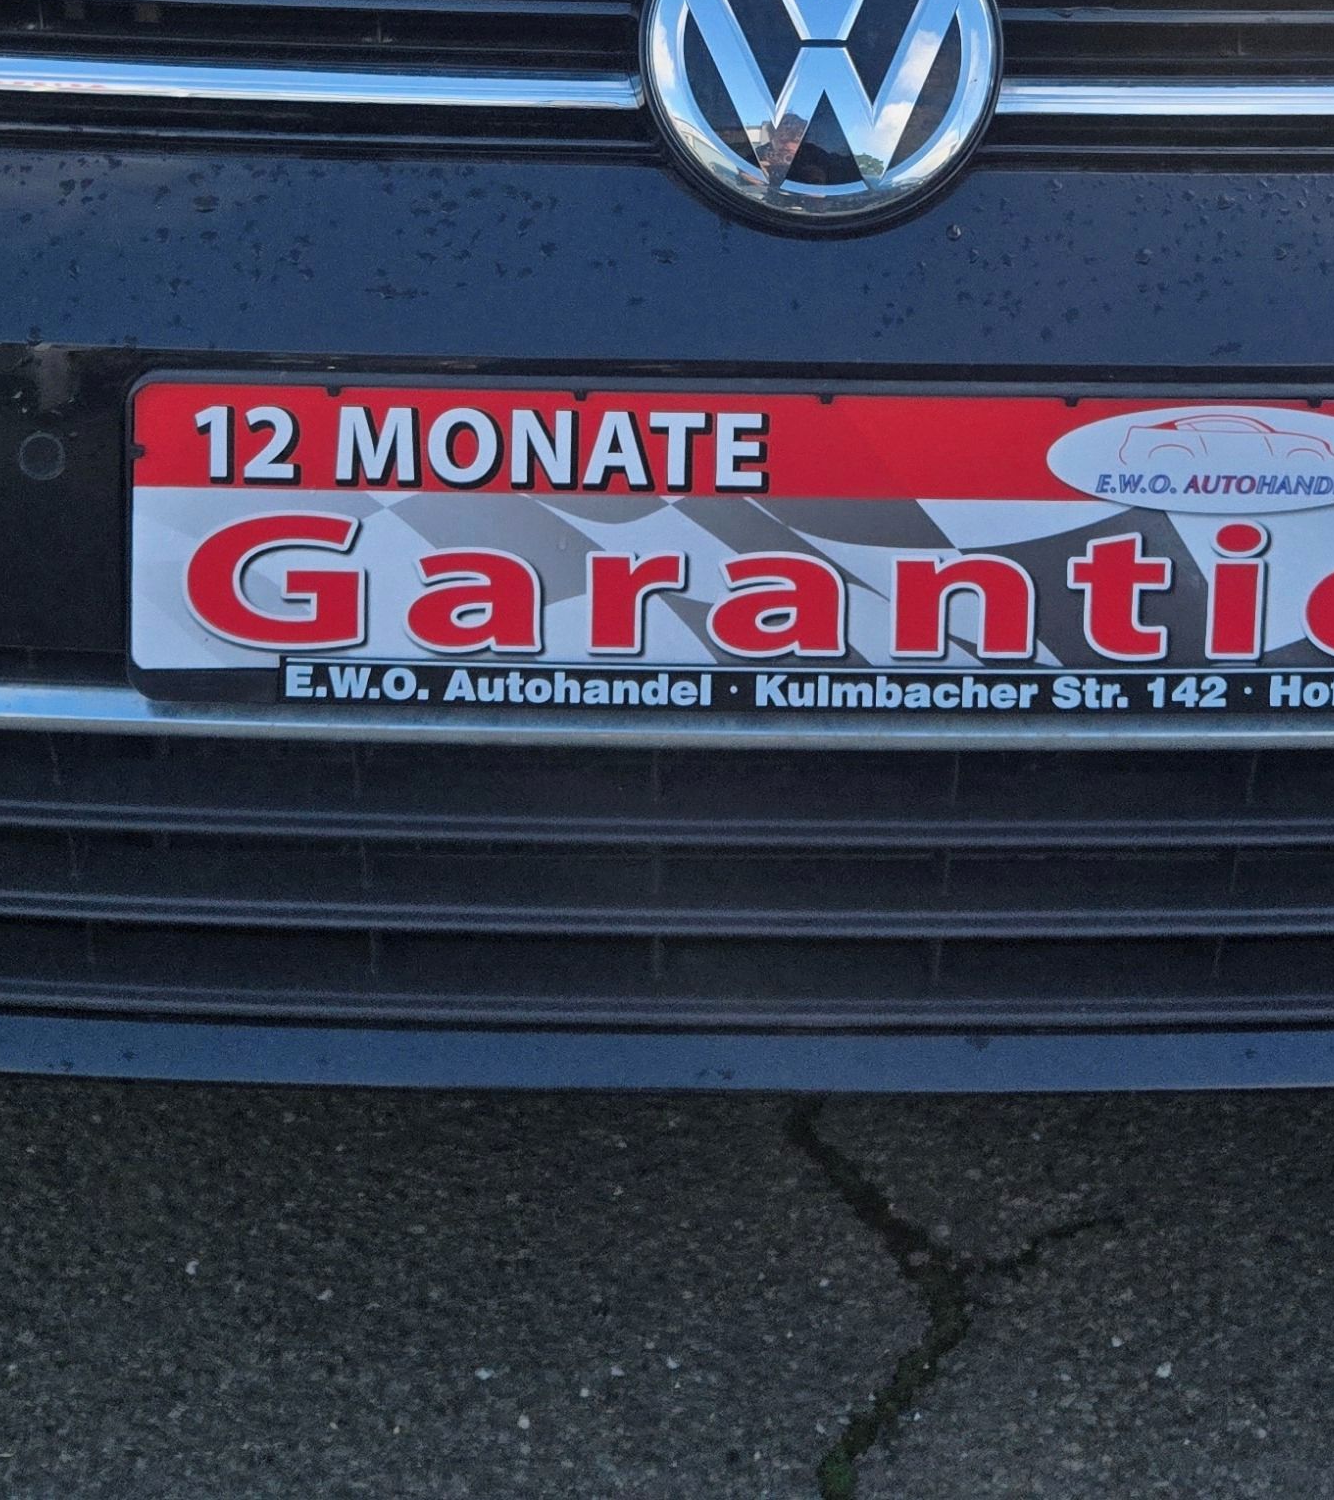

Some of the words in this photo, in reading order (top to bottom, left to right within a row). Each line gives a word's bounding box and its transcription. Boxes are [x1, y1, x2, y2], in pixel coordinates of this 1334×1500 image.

[194, 405, 301, 485] 12
[335, 405, 770, 492] MONATE
[1095, 473, 1178, 495] E.W.O.
[284, 665, 430, 701] E.W.O.
[442, 668, 713, 707] Autohandel
[754, 674, 1035, 709] Kulmbacher
[1050, 675, 1130, 709] Str.
[1146, 675, 1228, 709] 142
